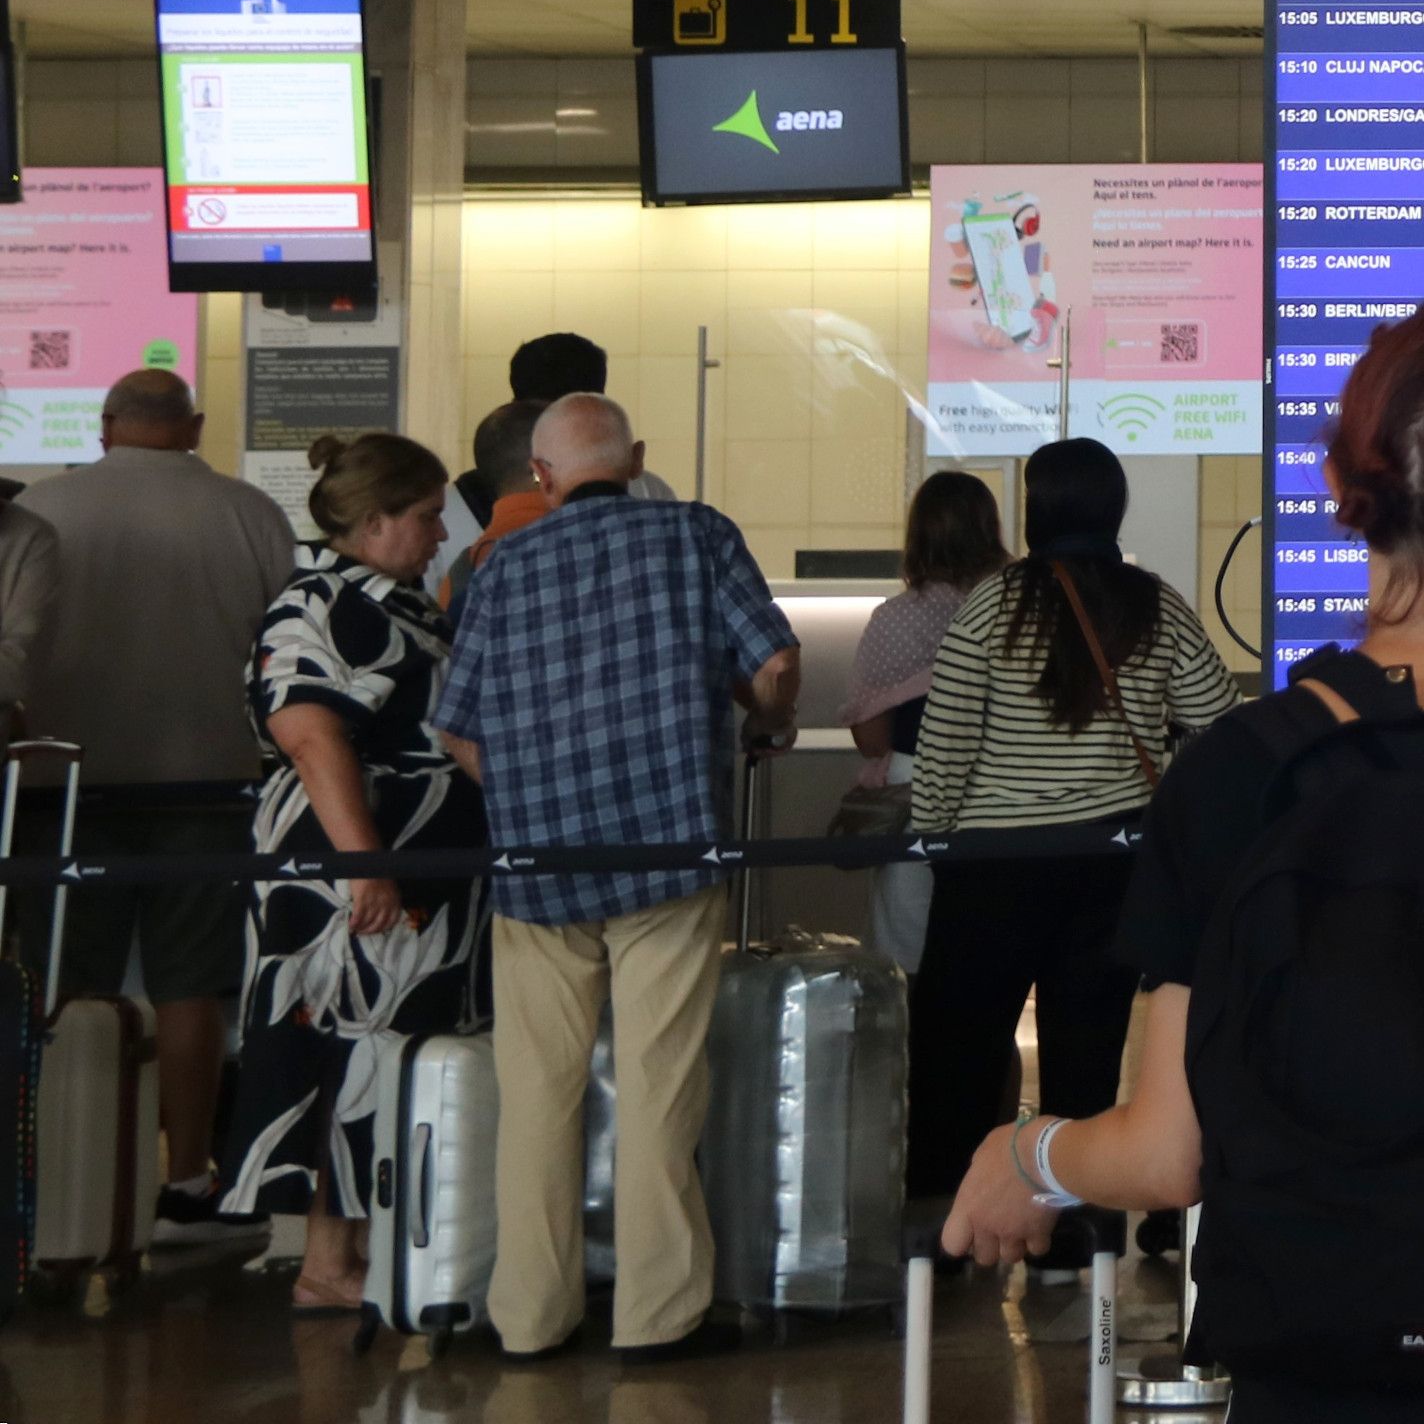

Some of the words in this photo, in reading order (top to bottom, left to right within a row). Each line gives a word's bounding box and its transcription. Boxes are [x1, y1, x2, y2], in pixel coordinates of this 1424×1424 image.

[776, 110, 842, 130] aena
[1279, 109, 1317, 122] 15:20
[1093, 240, 1119, 248] Need
[1138, 240, 1172, 249] airport
[1176, 239, 1202, 249] map?
[1174, 394, 1237, 406] AIRPORT
[939, 405, 967, 416] Free
[1174, 411, 1210, 423] FREE
[1215, 411, 1246, 423] WIFI
[1173, 429, 1213, 440] AENA
[1099, 1299, 1111, 1365] Saxoline
